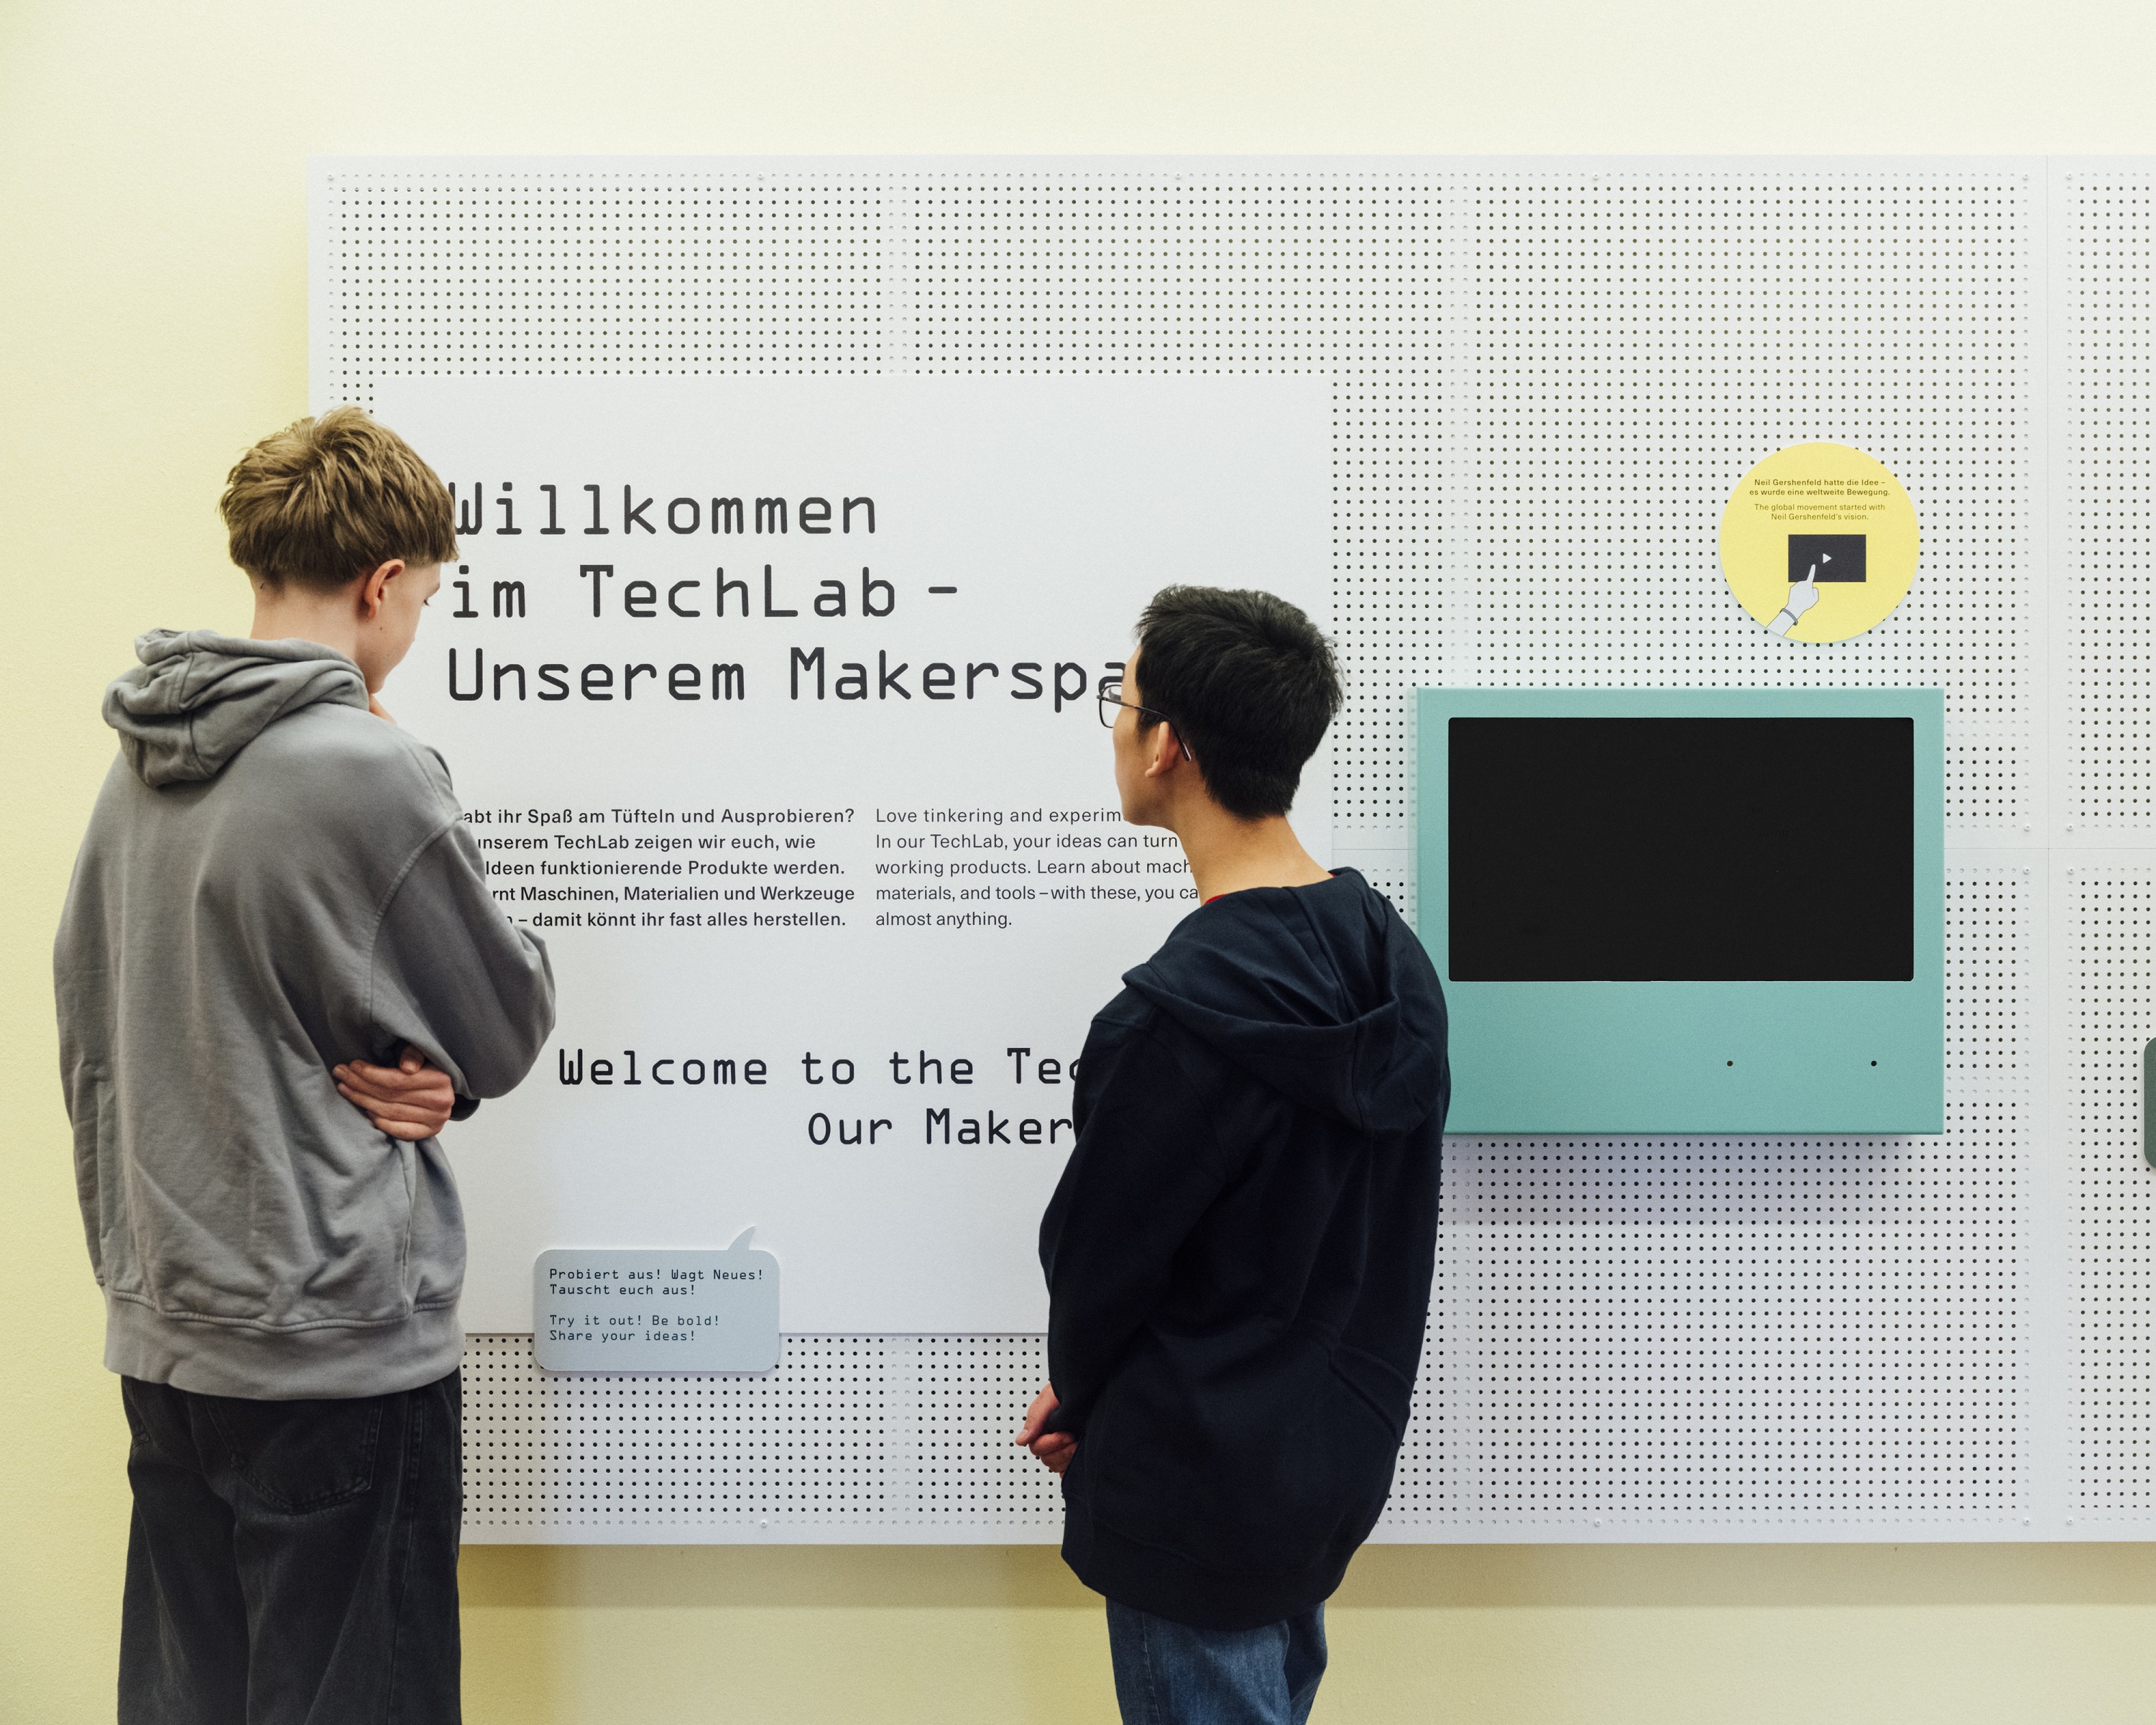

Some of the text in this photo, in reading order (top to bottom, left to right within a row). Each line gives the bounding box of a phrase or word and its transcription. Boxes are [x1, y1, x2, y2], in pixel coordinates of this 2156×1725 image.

[1846, 488, 1891, 497] Bewegung.
[448, 482, 875, 535] Willkommen
[1771, 503, 1795, 512] global
[1843, 512, 1869, 521] vision.
[452, 564, 526, 618] im
[579, 564, 895, 618] TechLab
[448, 648, 745, 702] Unserem
[498, 809, 522, 824] ihr
[528, 809, 573, 827] Spaß
[579, 812, 605, 824] am
[611, 809, 675, 824] Tüfteln
[681, 809, 714, 823] und
[721, 808, 854, 827] Ausprobieren?
[876, 808, 1127, 826] Love tinkering and experim
[553, 834, 630, 850] TechLab
[635, 834, 692, 852] zeigen
[698, 834, 726, 849] wir
[731, 834, 779, 852] euch,
[785, 834, 816, 849] wie
[876, 833, 1179, 852] In our TechLab, your ideas can turn
[486, 860, 844, 875] Ideen funktionierende Produkte werden.
[875, 860, 944, 878] working
[950, 860, 1031, 878] products.
[1038, 860, 1085, 874] Learn
[1091, 859, 1141, 874] about
[520, 886, 619, 903] Maschinen,
[624, 886, 719, 901] Materialien
[724, 886, 755, 901] und
[760, 886, 854, 903] Werkzeuge
[876, 886, 955, 903] materials,
[960, 886, 990, 900] and
[995, 886, 1036, 900] tools
[1090, 885, 1141, 902] these,
[1145, 888, 1174, 903] you
[532, 912, 582, 927] damit
[587, 912, 636, 926] könnt
[642, 912, 665, 926] ihr
[669, 911, 702, 926] fast
[707, 911, 748, 926] alles
[754, 911, 846, 926] herstellen.
[875, 911, 1012, 929] almost anything.
[559, 1048, 767, 1085] Welcome
[801, 1052, 854, 1085] to
[888, 1049, 973, 1085] the
[808, 1108, 1074, 1146] Our Maker
[549, 1268, 762, 1282] Probiert aus! Wagt Neues!
[549, 1284, 694, 1295] Tauscht euch aus!
[549, 1314, 718, 1328] Try it out! Be bold!
[549, 1330, 694, 1343] Share your ideas!
